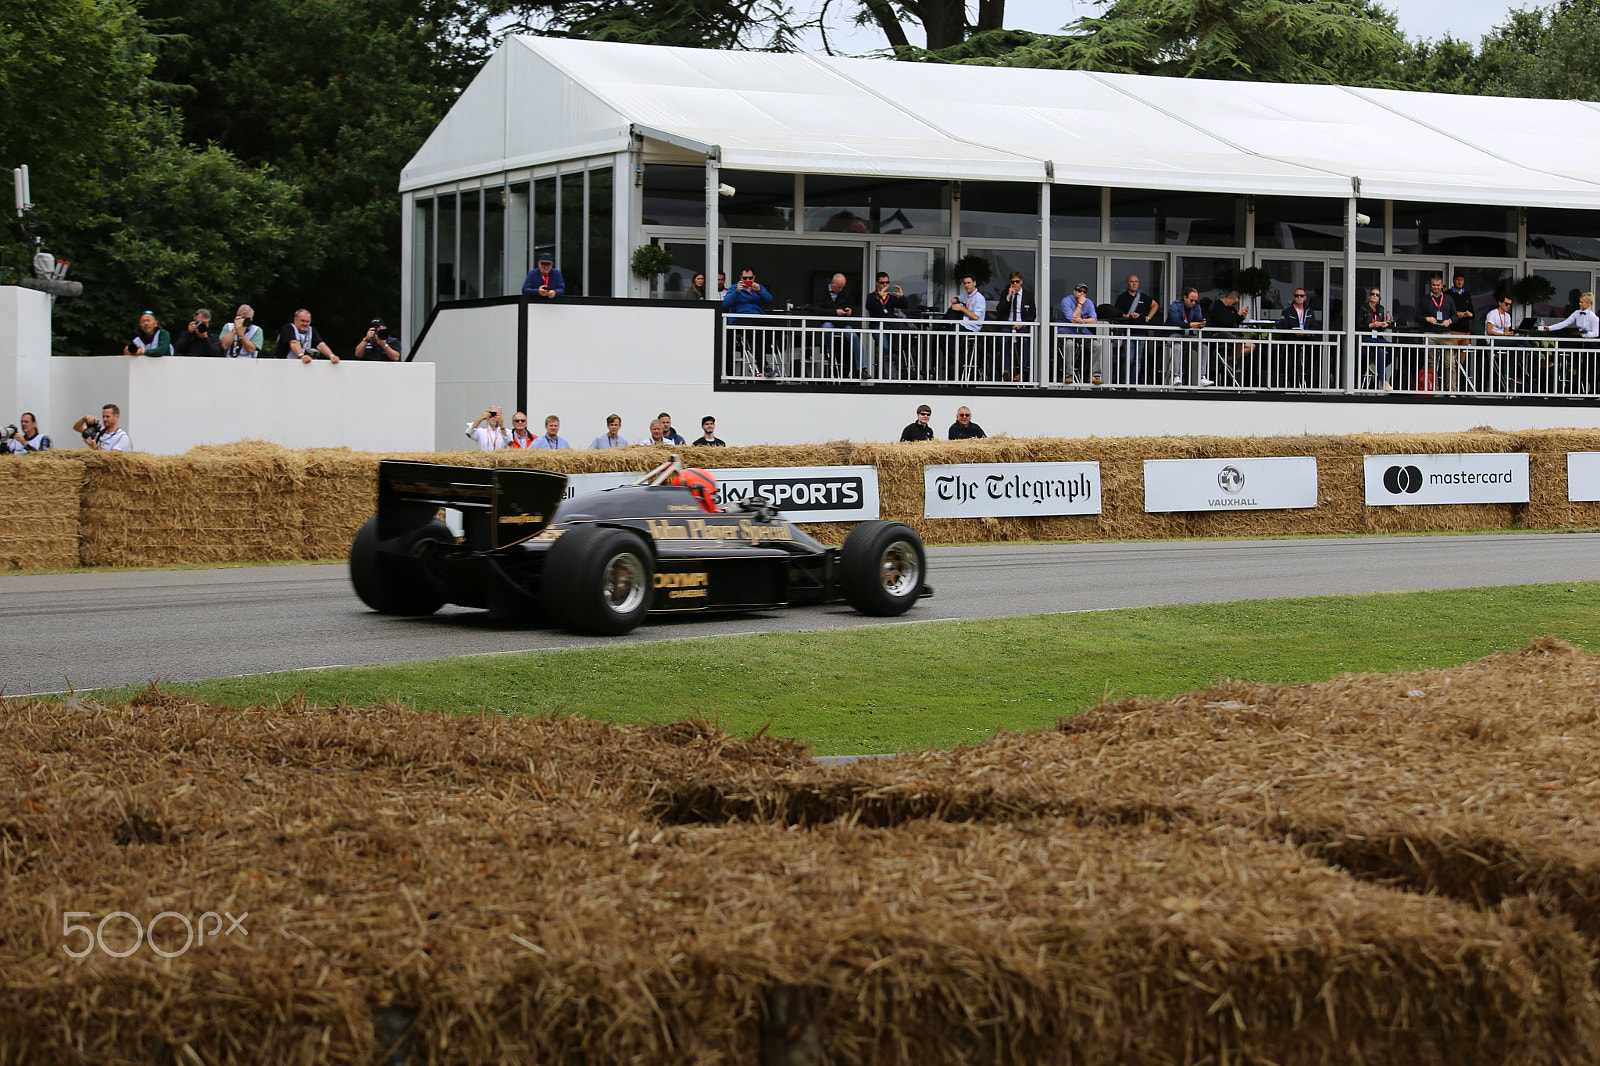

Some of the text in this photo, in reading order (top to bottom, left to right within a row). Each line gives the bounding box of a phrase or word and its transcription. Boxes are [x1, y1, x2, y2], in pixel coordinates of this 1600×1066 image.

[1430, 469, 1512, 484] mastercard
[561, 486, 575, 500] ell
[758, 482, 859, 506] SPORTS
[935, 473, 1091, 505] The Telegraph
[1208, 498, 1258, 507] VAUXHALL
